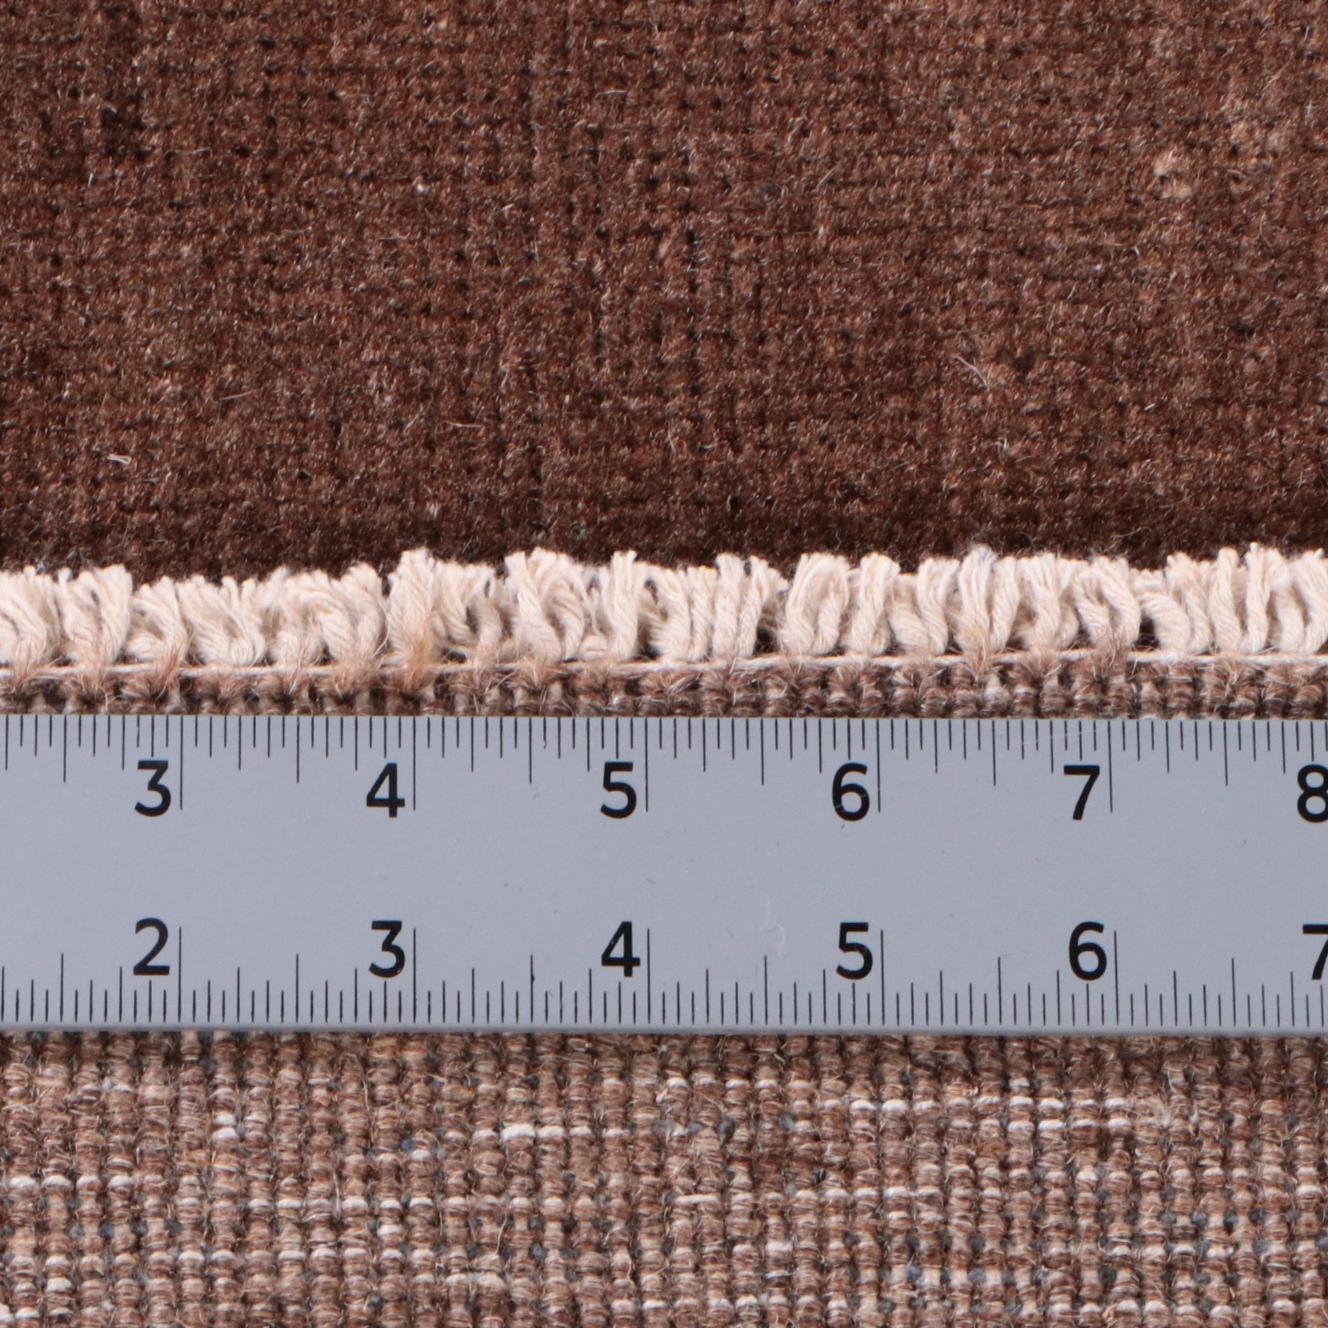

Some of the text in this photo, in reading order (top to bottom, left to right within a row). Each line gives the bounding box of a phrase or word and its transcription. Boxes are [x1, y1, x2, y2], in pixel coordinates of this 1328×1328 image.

[133, 758, 173, 819] 3
[365, 761, 407, 819] 4
[599, 760, 638, 820] 5
[830, 761, 871, 823] 6
[1062, 763, 1102, 822] 7
[132, 916, 172, 977] 2
[367, 919, 407, 980] 3
[600, 920, 642, 979] 4
[834, 920, 875, 982] 5
[1067, 920, 1109, 982] 6
